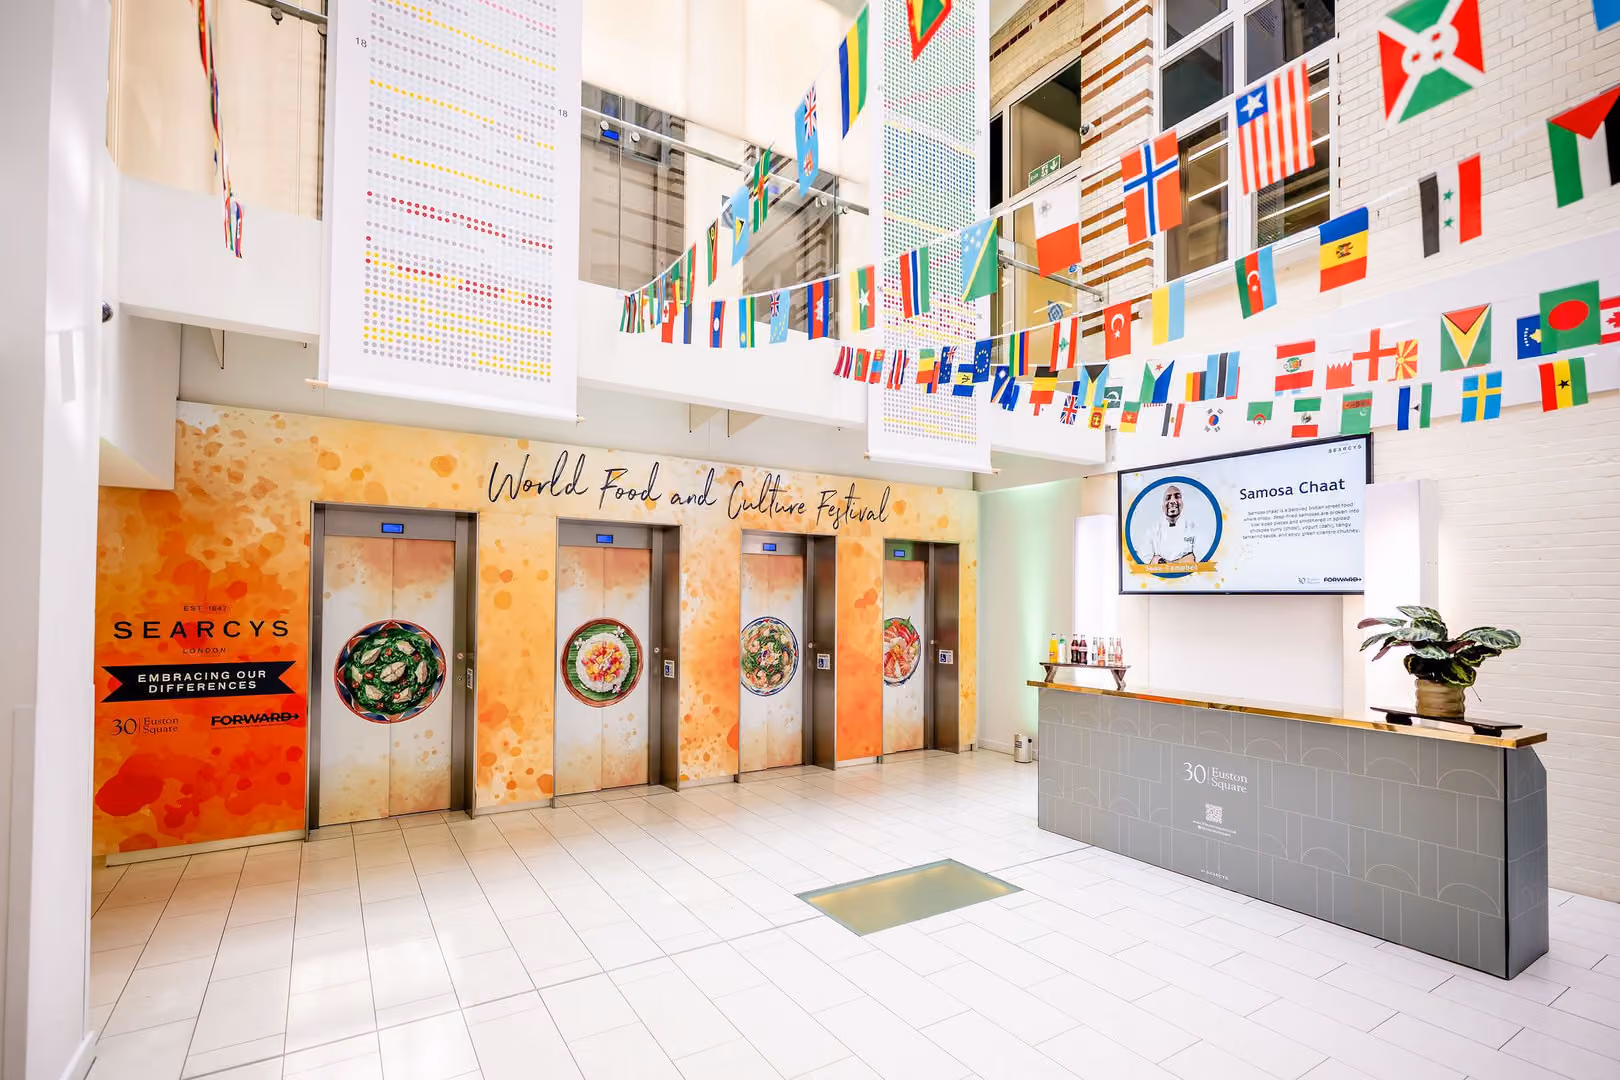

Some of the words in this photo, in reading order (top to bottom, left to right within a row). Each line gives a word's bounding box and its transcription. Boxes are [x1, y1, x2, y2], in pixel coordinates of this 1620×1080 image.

[356, 37, 367, 48] 18
[559, 109, 568, 117] 18
[1328, 444, 1362, 453] SEARCYS
[488, 450, 589, 503] World
[599, 461, 662, 511] Food
[670, 467, 717, 507] and
[727, 473, 807, 520] Culture
[816, 482, 891, 529] Festival
[1240, 486, 1294, 500] Samosa
[1299, 478, 1346, 494] Chaat
[114, 620, 289, 639] SEARCYS
[138, 671, 230, 683] EMBRACING
[236, 670, 266, 680] OUR
[148, 680, 257, 694] DIFFERENCES
[144, 717, 179, 726] Euston
[211, 712, 292, 726] FORWARD
[112, 718, 137, 736] 30
[143, 726, 178, 734] Square
[1183, 762, 1206, 784] 30
[1211, 766, 1248, 783] Euston
[1211, 777, 1248, 793] Square
